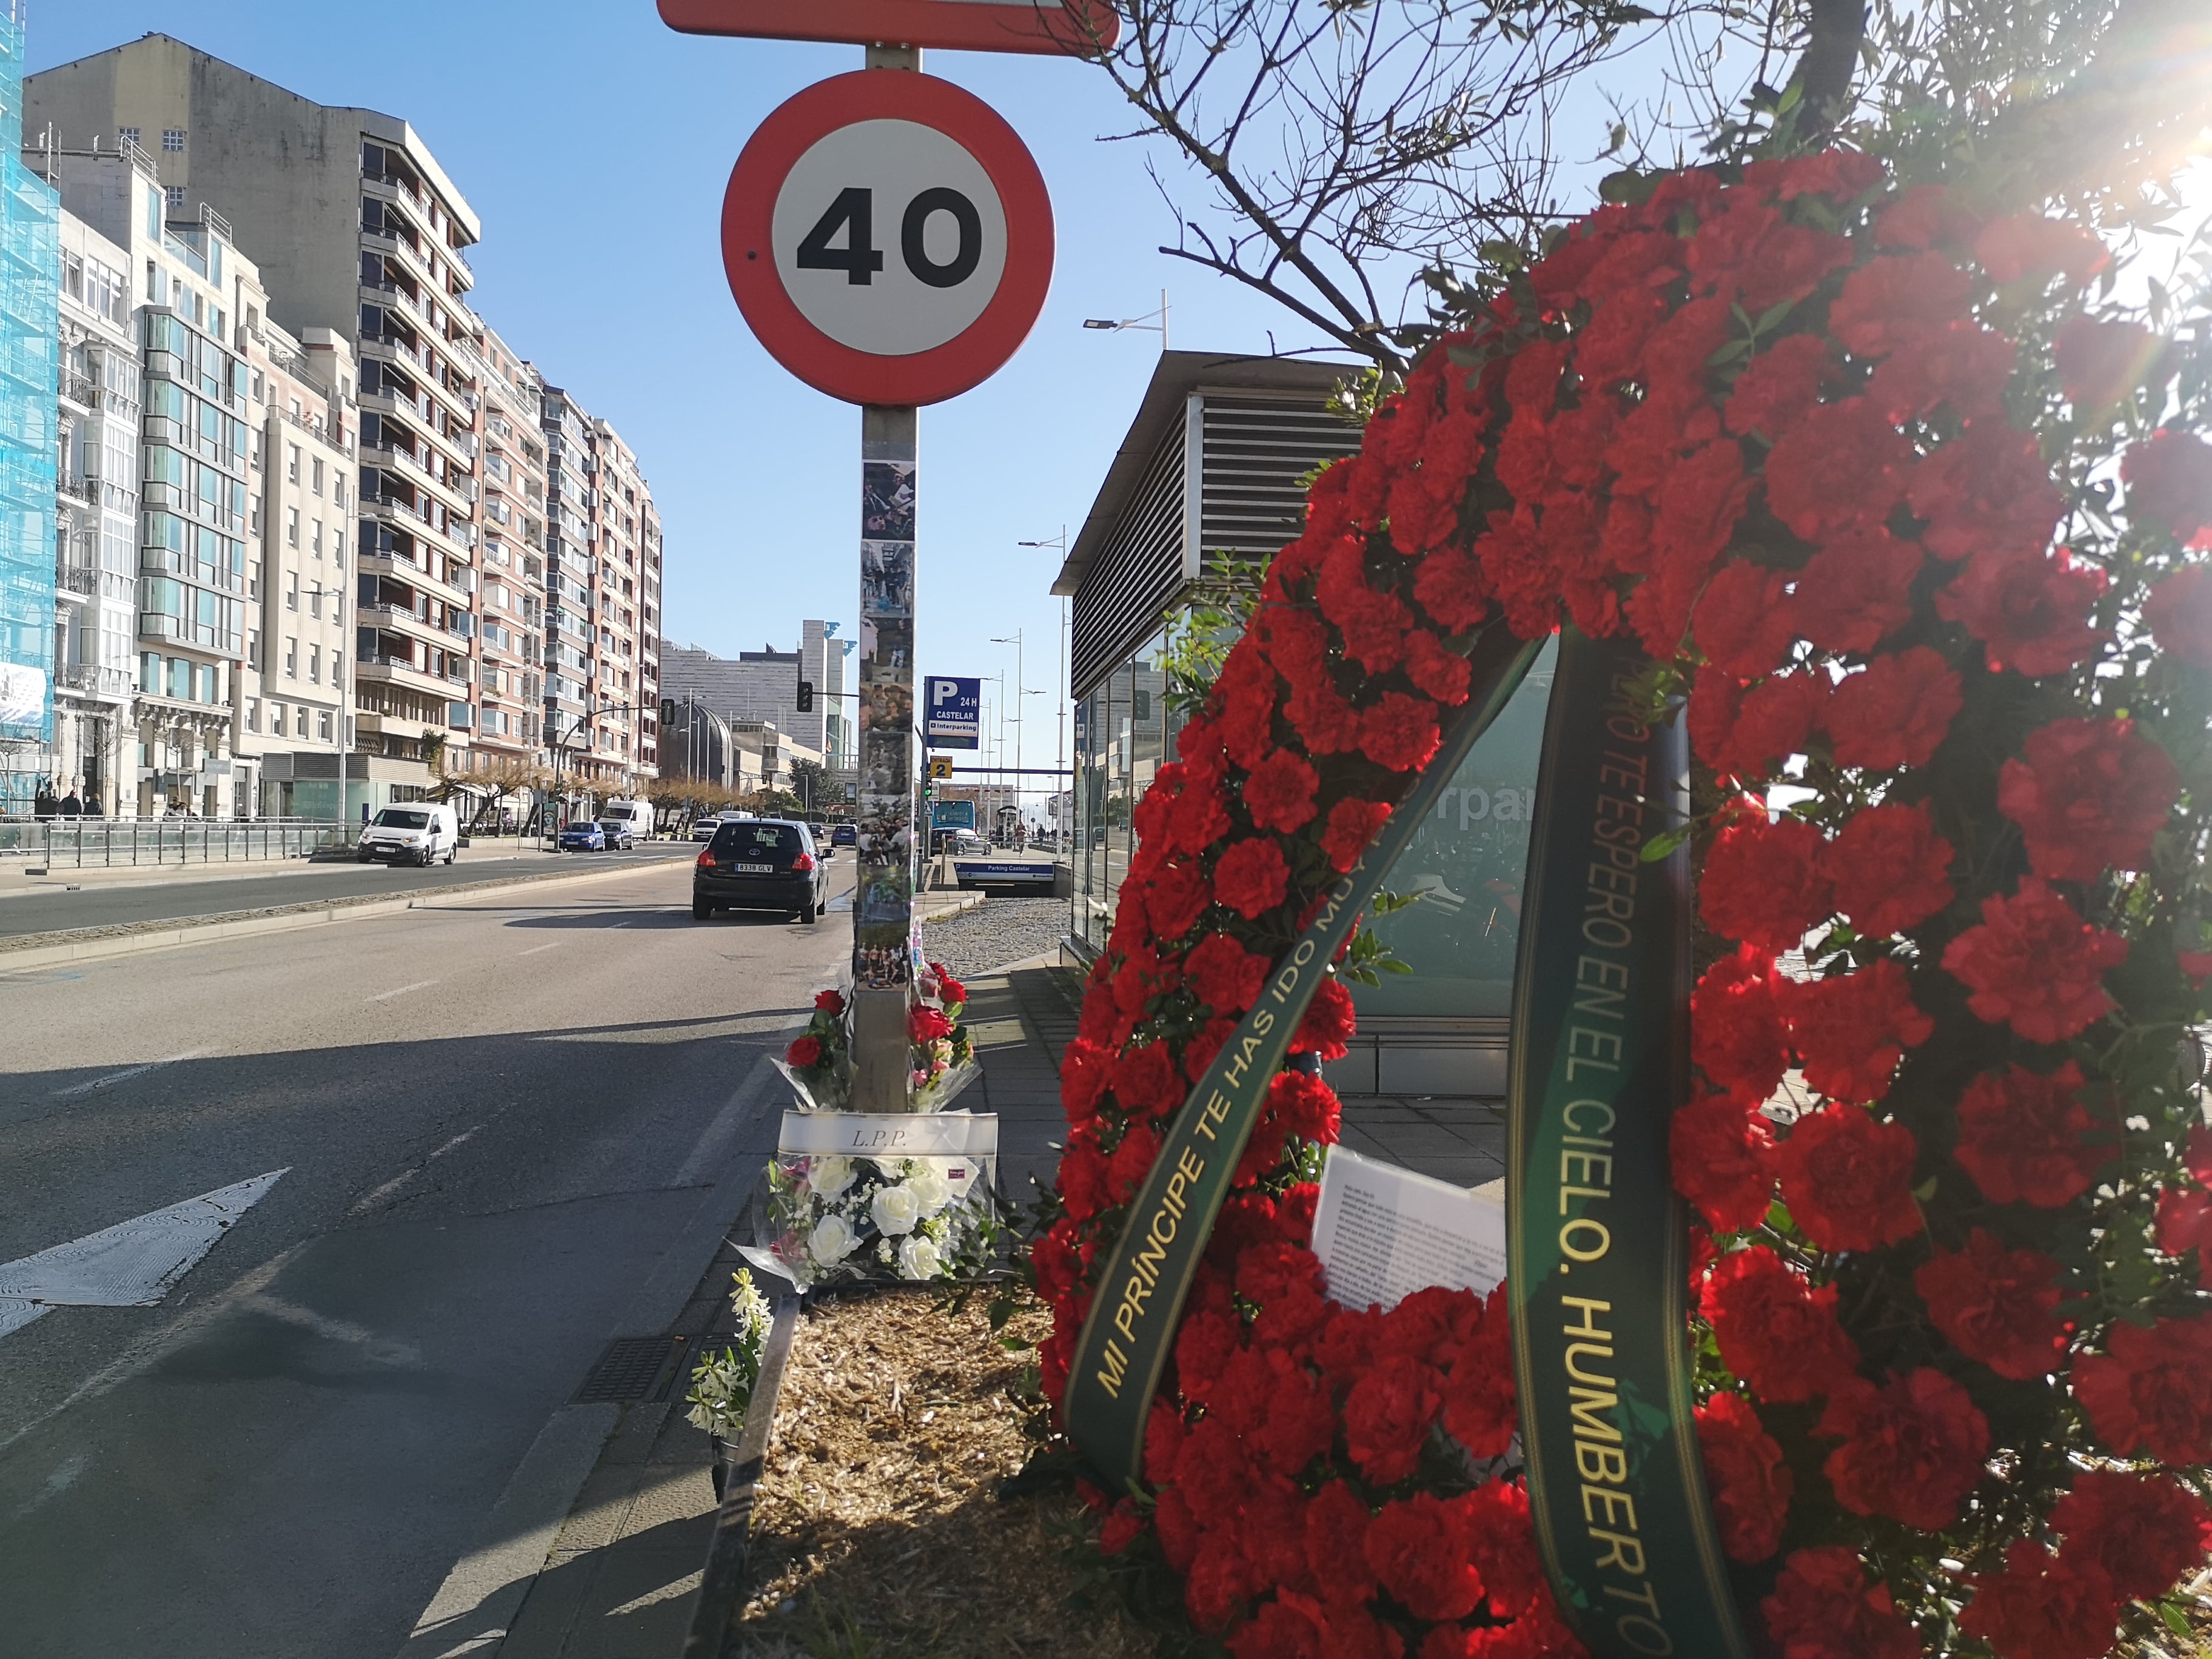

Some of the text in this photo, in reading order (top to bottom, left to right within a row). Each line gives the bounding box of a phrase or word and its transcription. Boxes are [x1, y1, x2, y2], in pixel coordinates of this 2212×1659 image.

[797, 187, 982, 288] 40
[934, 680, 958, 706] P
[936, 711, 974, 720] CASTELAR
[960, 697, 977, 707] 24 H
[937, 723, 976, 732] Interparking
[936, 764, 945, 776] 2
[1600, 749, 1647, 785] TE
[1582, 794, 1643, 948] ESPERO
[1574, 954, 1629, 1020] EN
[1566, 1025, 1623, 1082] EL
[1096, 1338, 1129, 1399] MI
[1114, 1145, 1205, 1342] PRÍNCIPE
[1193, 1088, 1232, 1142] TE
[1224, 1009, 1275, 1090] HAS
[1272, 939, 1316, 1005] IDO
[1559, 1099, 1617, 1275] CIELO.
[1561, 1295, 1674, 1657] HUMBERTO
